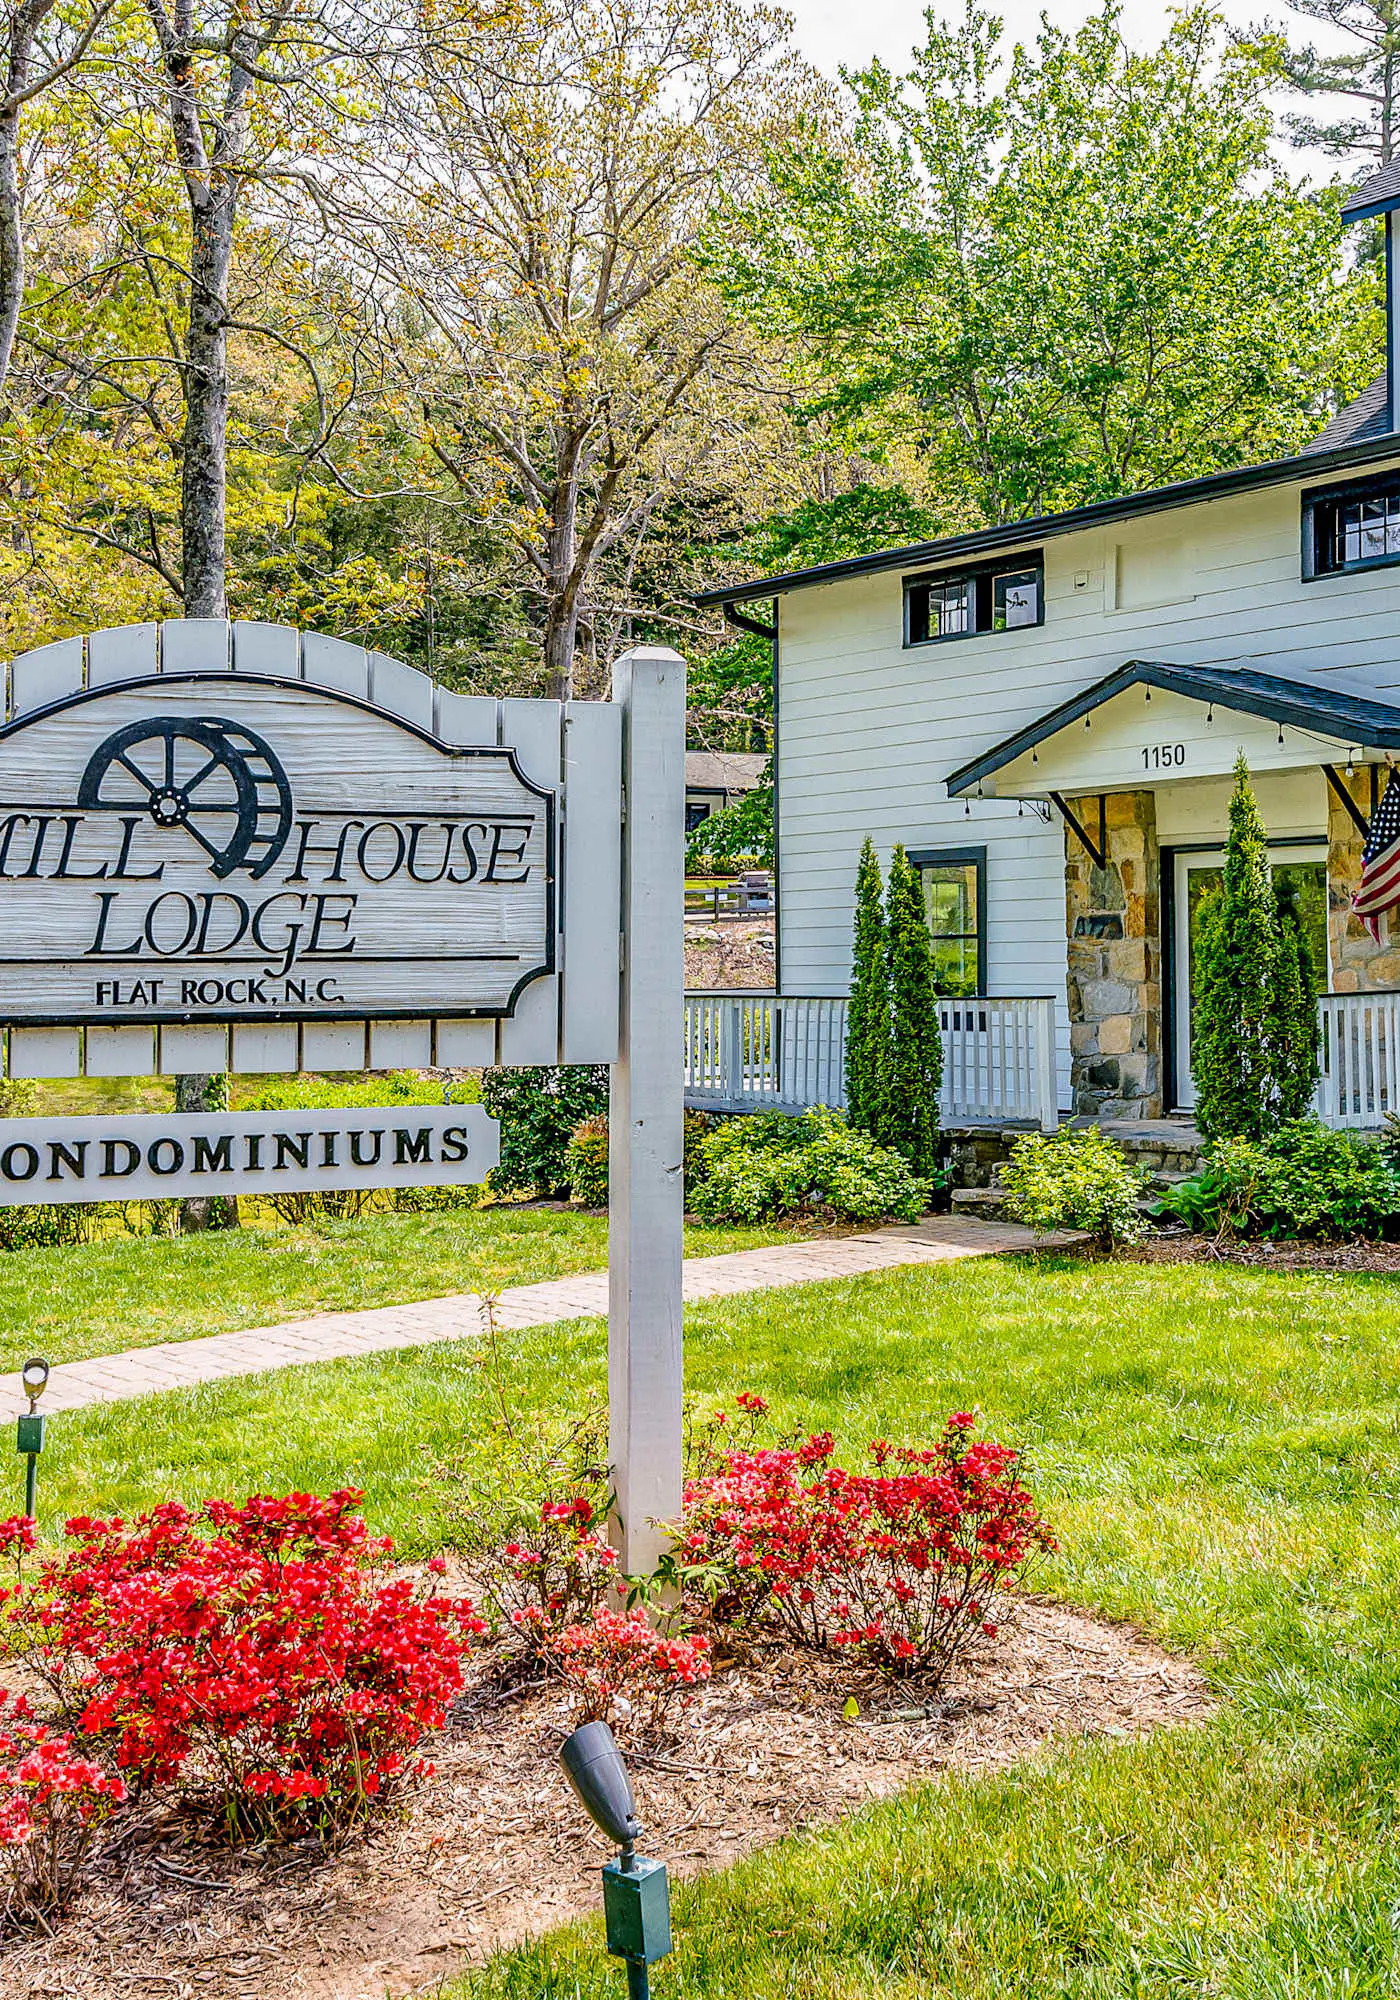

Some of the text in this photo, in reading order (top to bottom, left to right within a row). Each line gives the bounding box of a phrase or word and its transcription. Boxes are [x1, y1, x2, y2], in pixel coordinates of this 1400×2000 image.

[1141, 744, 1185, 769] 1150
[284, 820, 532, 883] HOUSE
[84, 891, 358, 978] LODGE
[96, 979, 164, 1006] FLAT
